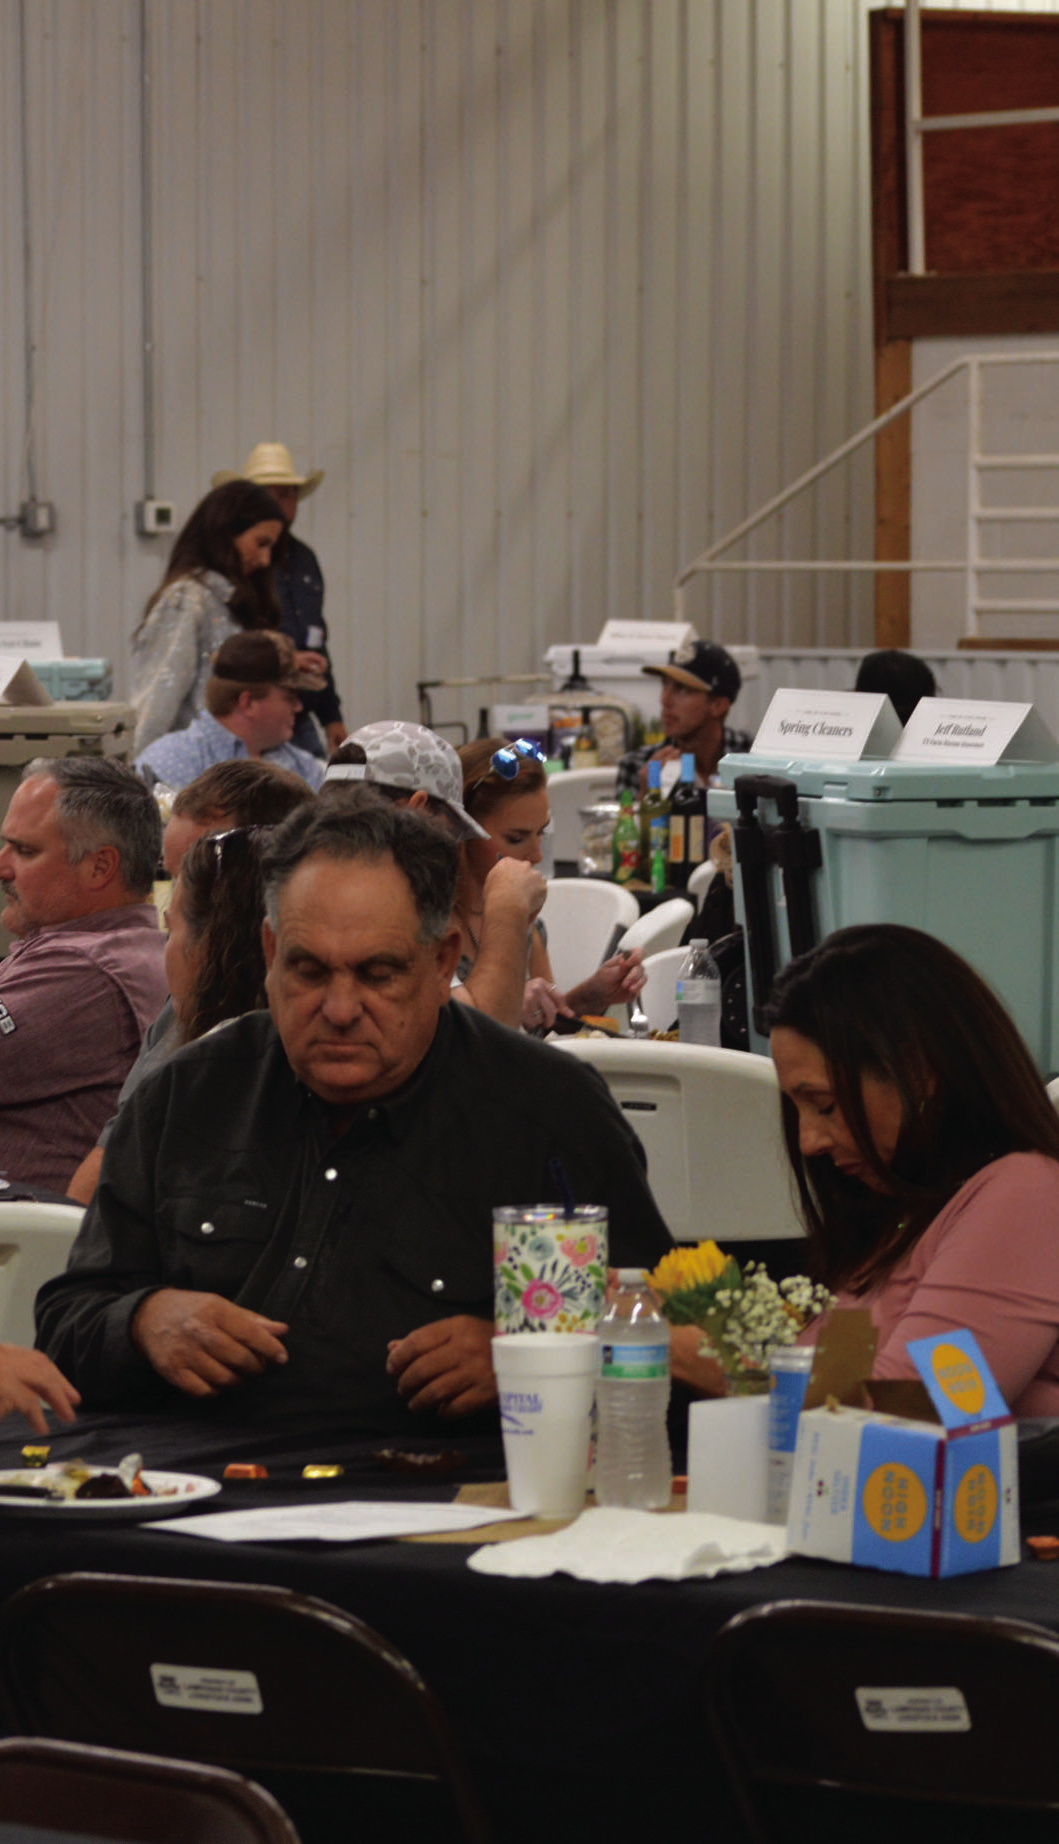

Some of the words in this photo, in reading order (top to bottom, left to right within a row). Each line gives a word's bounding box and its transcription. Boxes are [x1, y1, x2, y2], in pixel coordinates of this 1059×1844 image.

[778, 719, 811, 736] Spring
[812, 720, 854, 737] Cleaners
[880, 1470, 895, 1532] NOON
[895, 1477, 909, 1530] HIGH
